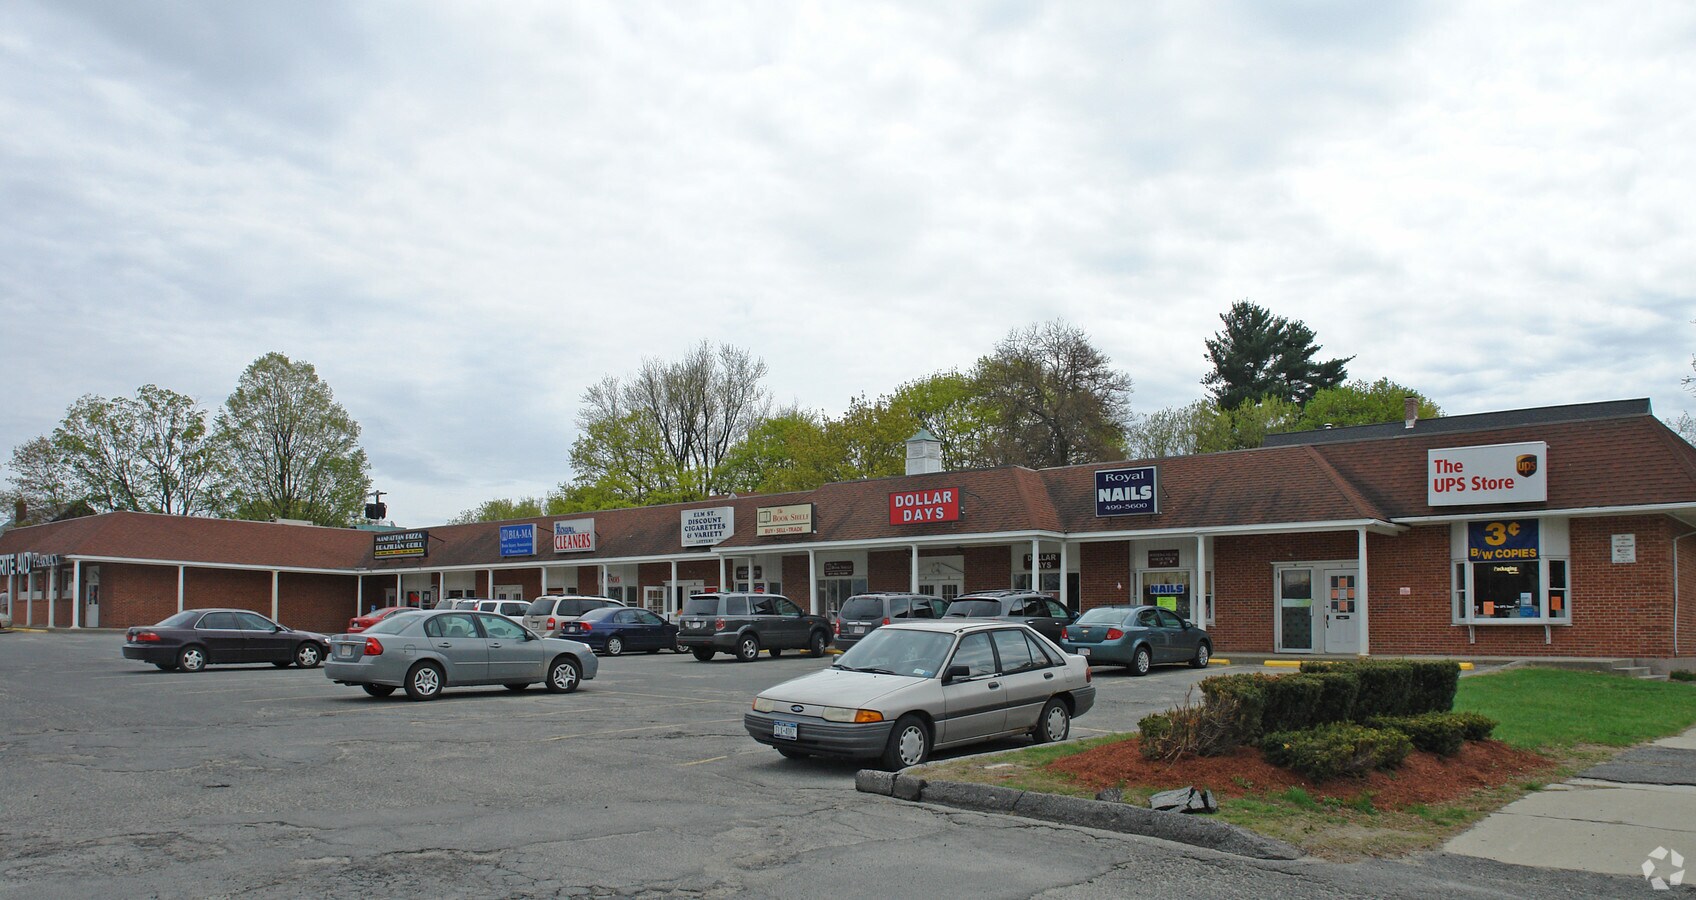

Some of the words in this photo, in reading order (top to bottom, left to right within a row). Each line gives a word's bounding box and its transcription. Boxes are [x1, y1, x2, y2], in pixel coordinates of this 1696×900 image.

[1433, 459, 1464, 474] The
[1518, 462, 1536, 474] ups
[1105, 471, 1144, 482] Royal
[1433, 477, 1466, 492] UPS
[1471, 476, 1515, 490] Store
[895, 491, 952, 508] DOLLAR
[1098, 485, 1152, 502] NAILS
[688, 517, 722, 525] DISCOUNT
[903, 507, 944, 522] DAYS
[508, 529, 532, 540] BIA-MA
[684, 524, 726, 532] CIGARETTES
[555, 533, 591, 550] CLEANERS
[1470, 548, 1494, 560] B/W
[1495, 548, 1537, 558] COPIES
[0, 554, 16, 576] RITE
[17, 552, 32, 574] AID
[1151, 585, 1183, 593] NAILS
